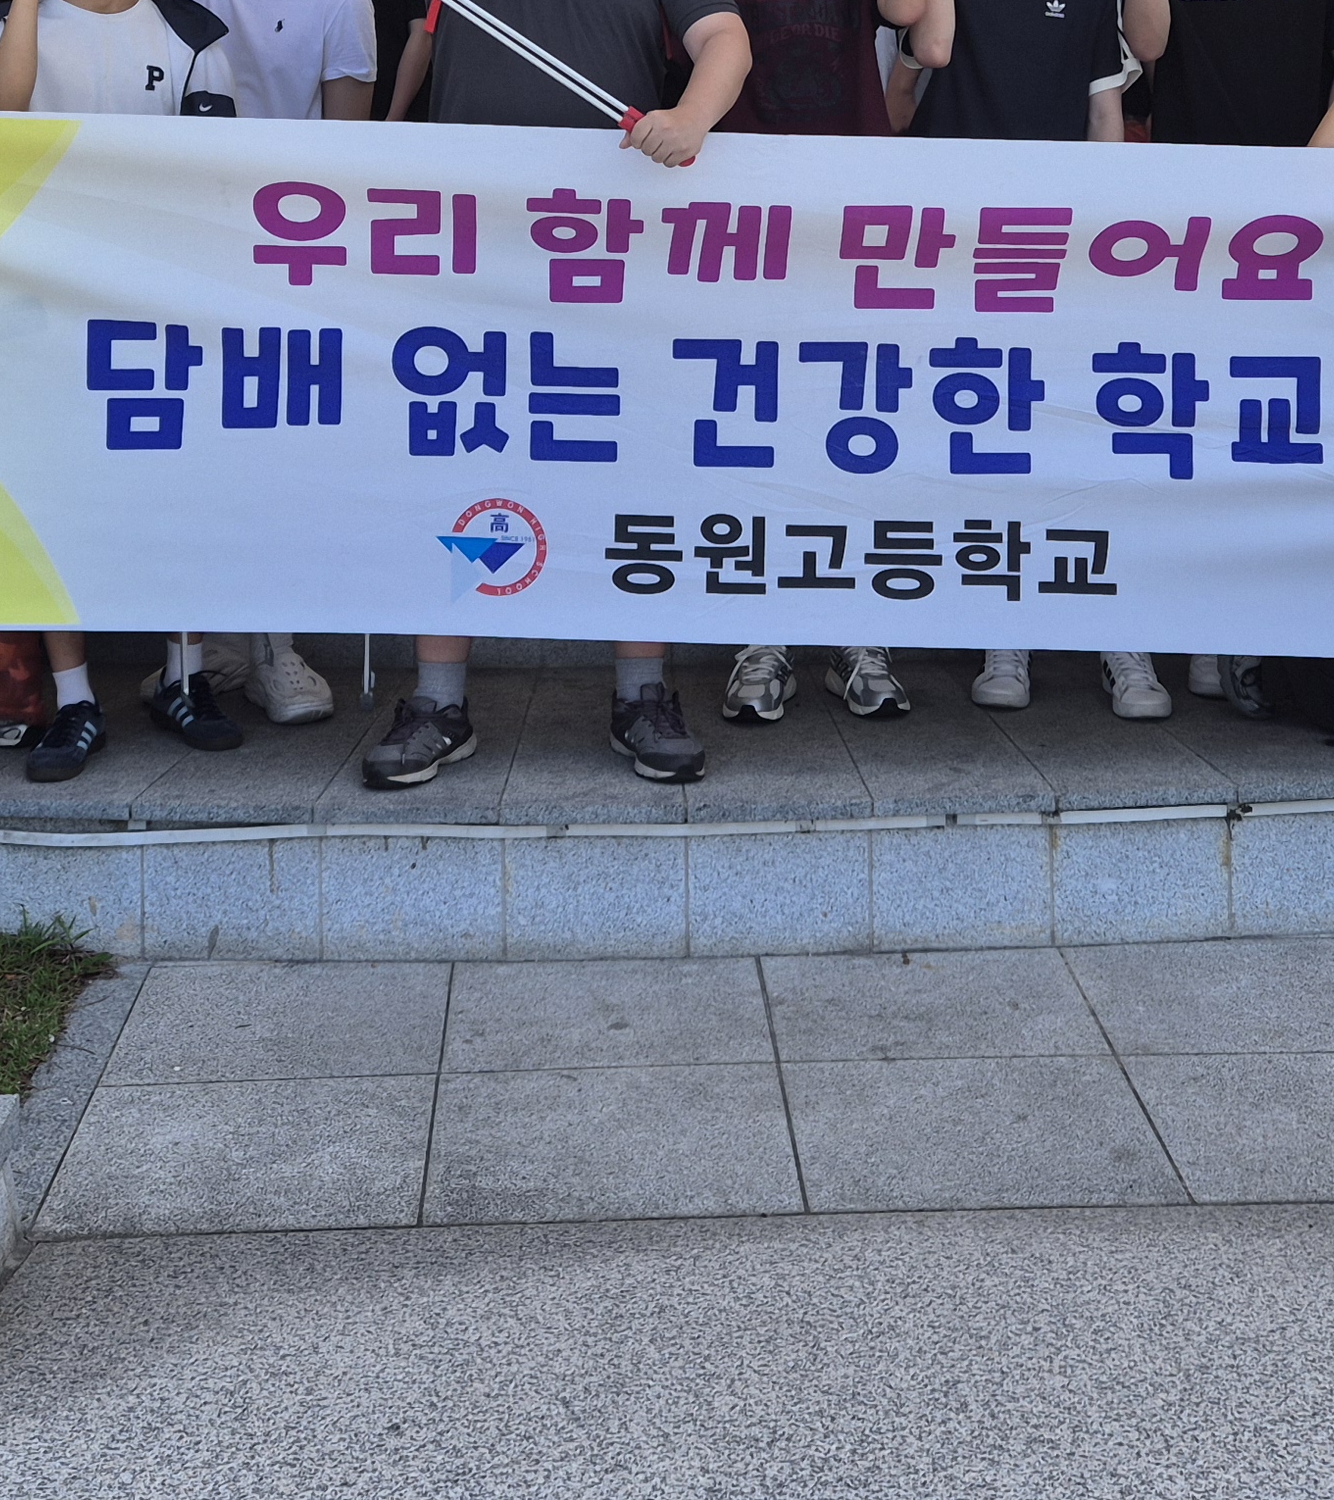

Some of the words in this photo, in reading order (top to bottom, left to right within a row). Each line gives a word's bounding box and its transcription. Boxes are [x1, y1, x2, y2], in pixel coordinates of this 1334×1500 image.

[145, 65, 165, 91] P
[253, 181, 477, 285] 우리
[526, 188, 792, 303] 함께
[839, 205, 1324, 313] 만들어요
[86, 319, 343, 450] 담배
[391, 326, 621, 462] 없는
[672, 337, 1045, 474] 건강한
[458, 500, 525, 527] DONGWON
[490, 513, 510, 533] 高
[529, 518, 546, 551] HIGH
[605, 513, 1118, 601] 동원고등학교
[496, 561, 544, 596] SCHOOL
